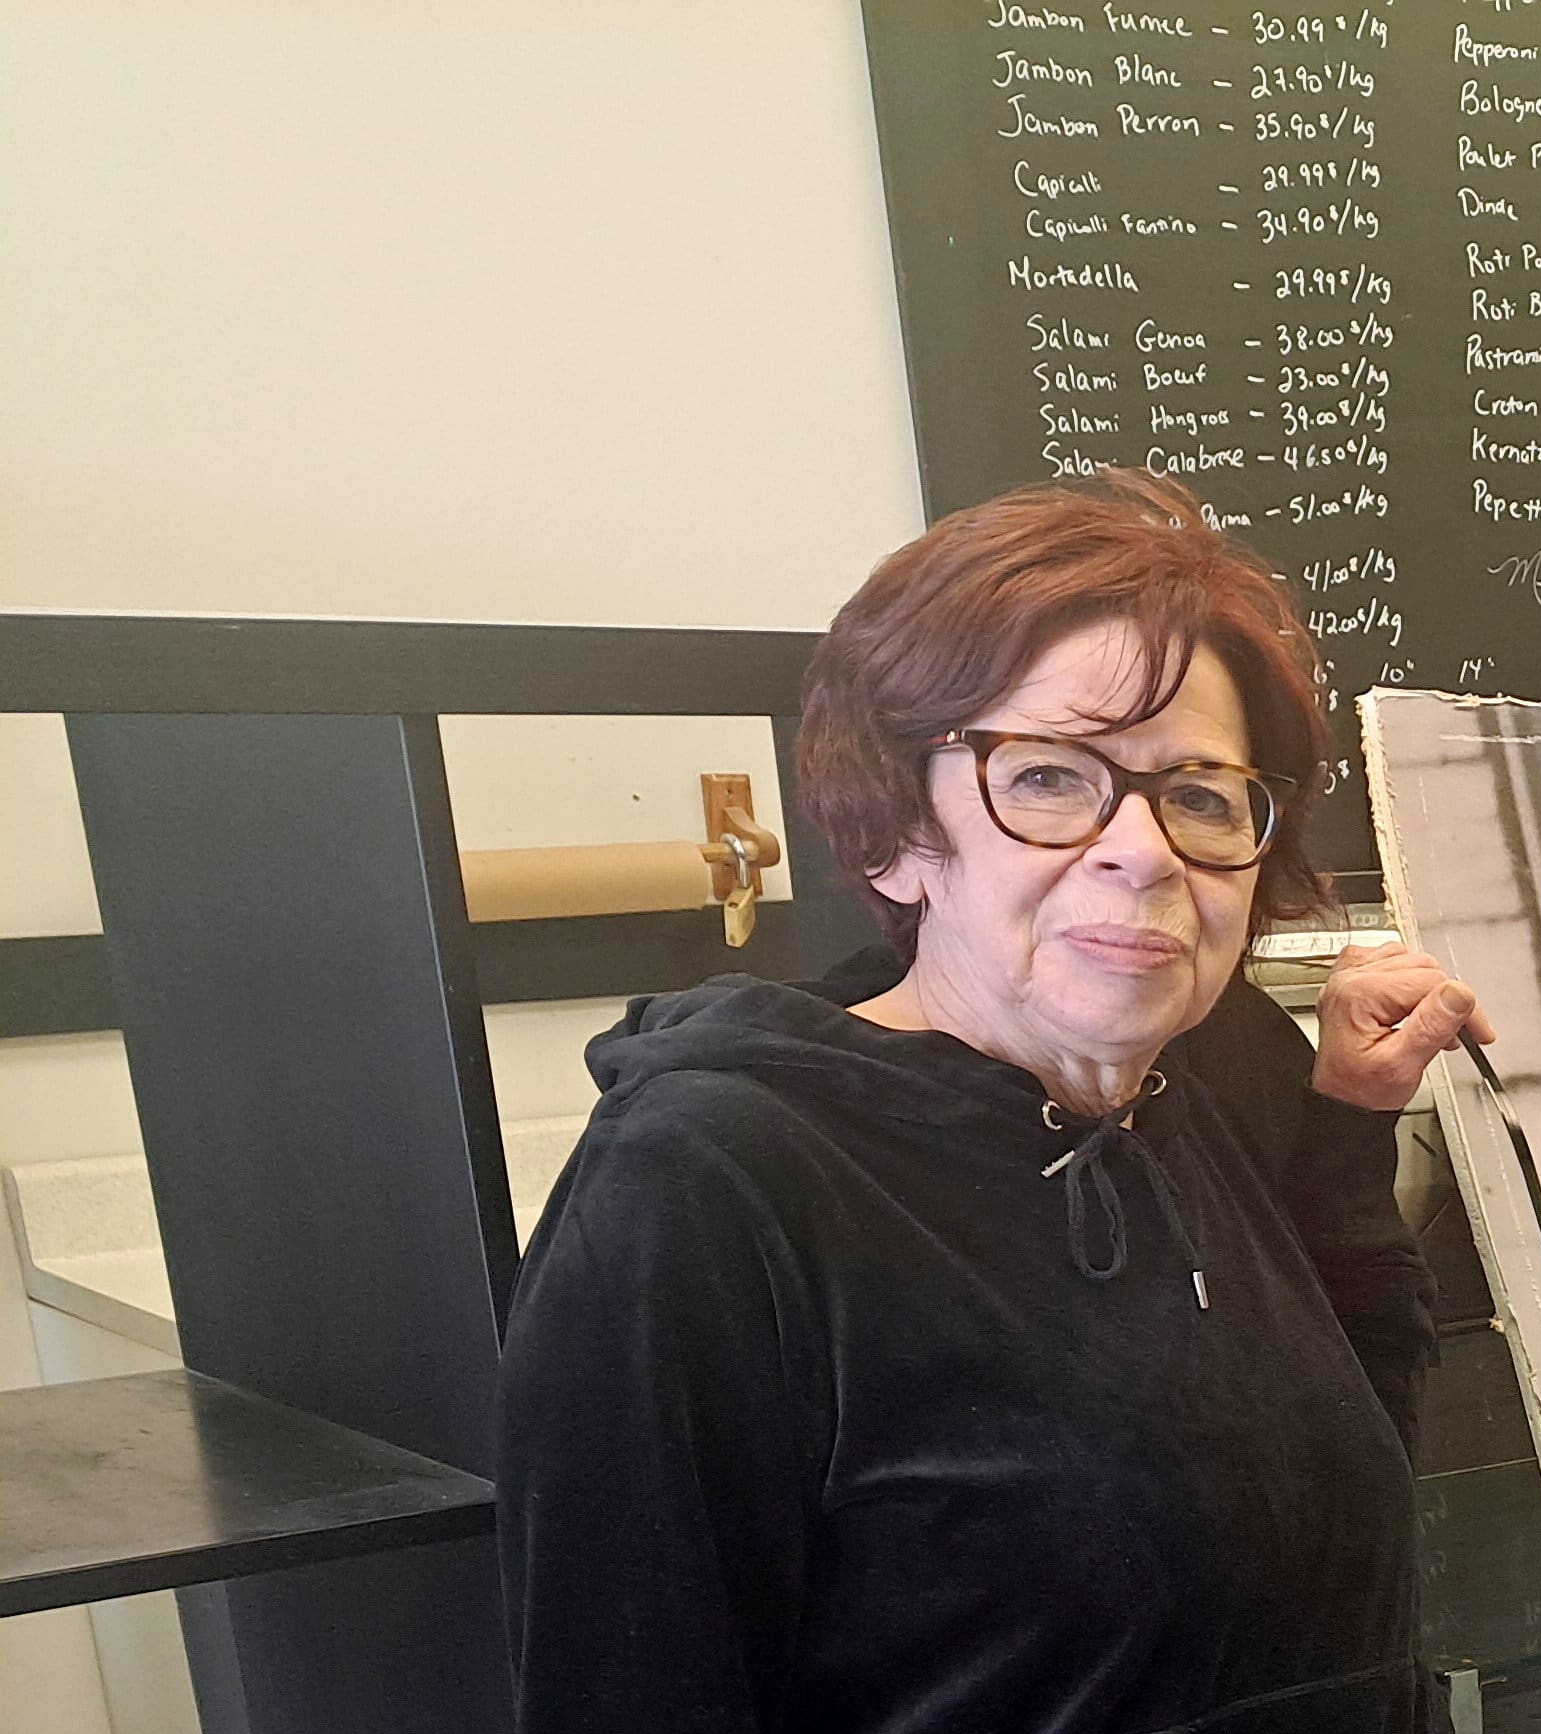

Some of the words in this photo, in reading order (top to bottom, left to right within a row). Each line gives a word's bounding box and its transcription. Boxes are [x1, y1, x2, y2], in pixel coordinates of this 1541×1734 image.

[987, 2, 1085, 33] Jambon
[1454, 23, 1539, 68] Pepperoni
[991, 50, 1093, 88] Jambon
[1114, 53, 1182, 88] Blanc
[997, 93, 1099, 138] Jambon
[1458, 135, 1517, 172] Poulet
[1457, 187, 1519, 222] Dinde
[1008, 255, 1140, 293] Mortadella
[1026, 313, 1110, 352] Salami
[1135, 318, 1207, 353] Genoa
[1032, 362, 1118, 393] Salami
[1039, 403, 1120, 436] Salami
